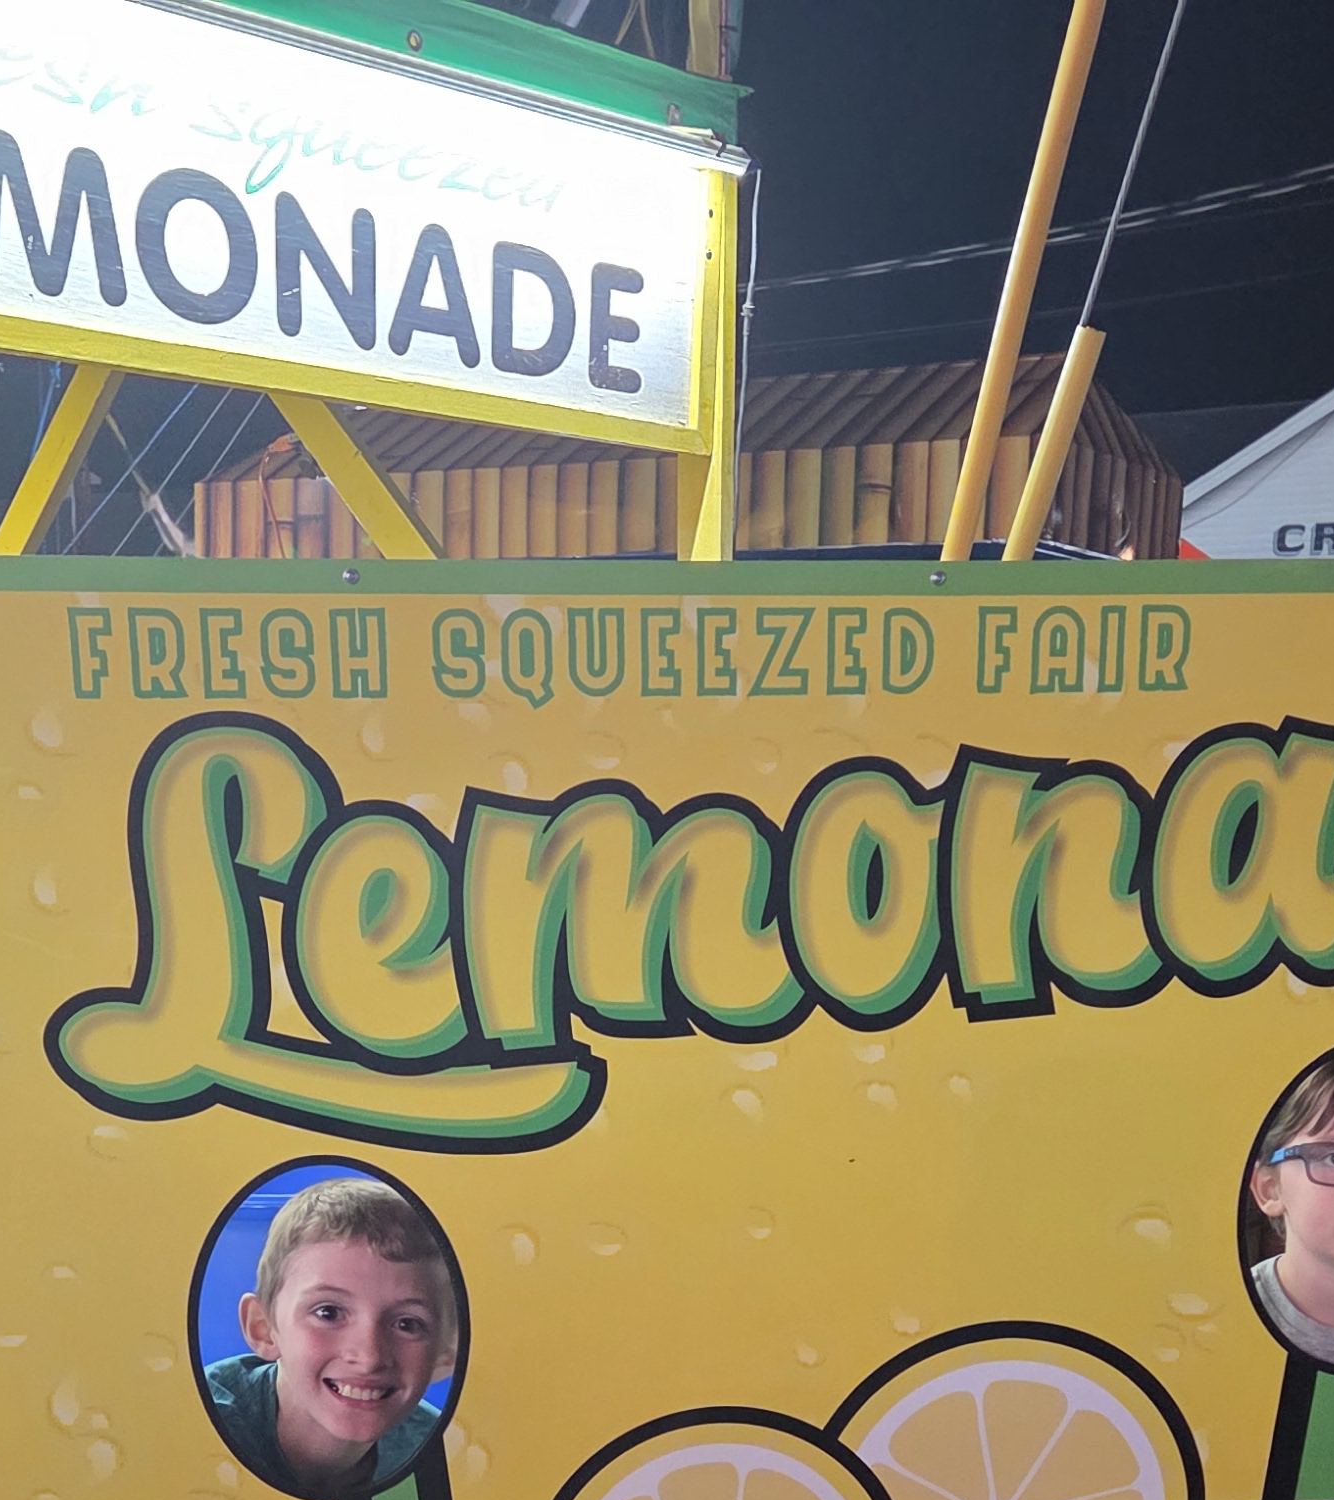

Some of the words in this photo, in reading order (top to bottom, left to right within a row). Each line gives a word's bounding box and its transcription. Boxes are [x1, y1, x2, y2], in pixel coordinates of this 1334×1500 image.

[67, 605, 389, 700] FRESH
[431, 605, 935, 710] SQUEEZED
[977, 602, 1193, 695] FAIR
